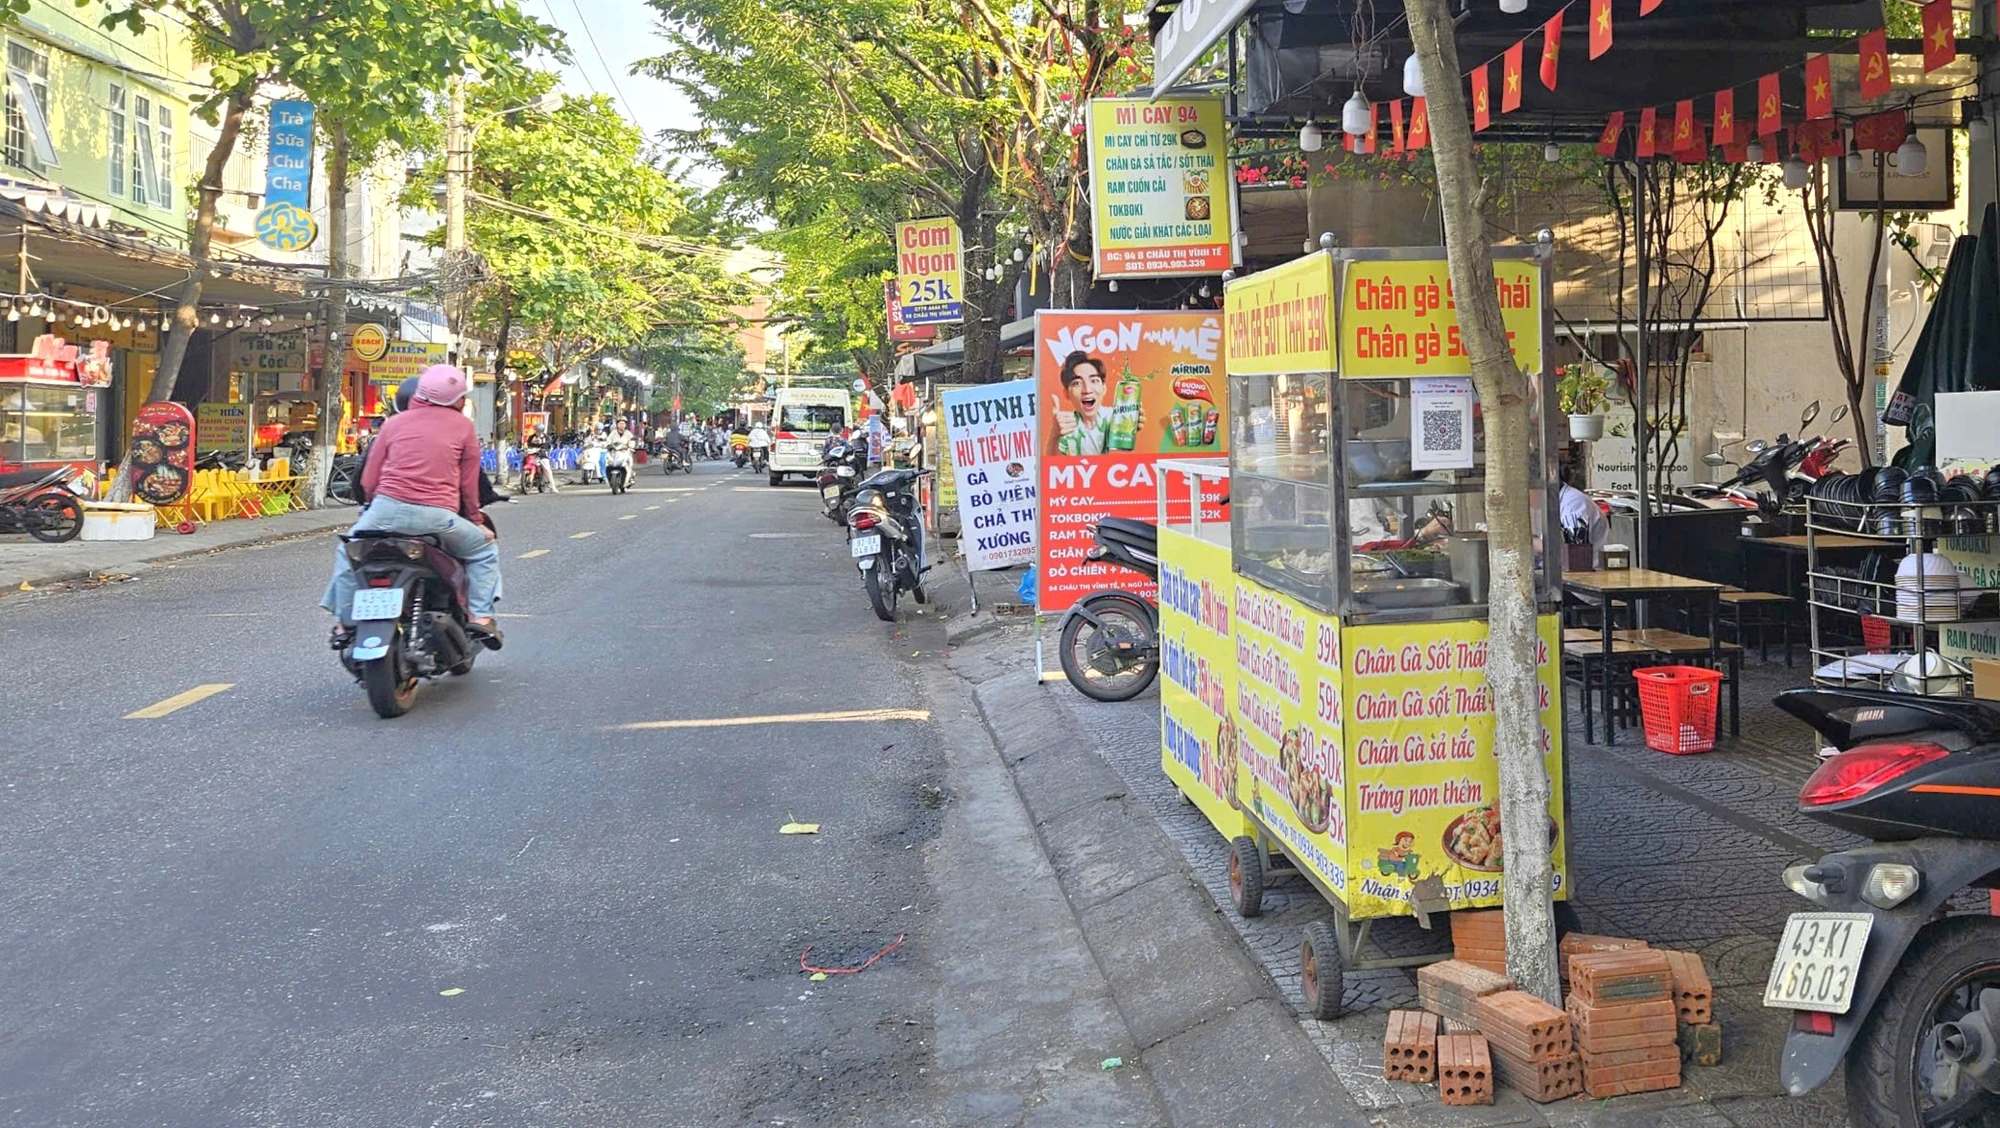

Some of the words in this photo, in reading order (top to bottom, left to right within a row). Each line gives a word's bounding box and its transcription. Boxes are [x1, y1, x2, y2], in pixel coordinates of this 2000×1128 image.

[280, 111, 304, 125] Trà
[1116, 104, 1137, 124] MÌ
[1142, 106, 1172, 124] CAY
[1177, 106, 1197, 122] 94
[275, 133, 304, 147] Sữa
[1117, 135, 1132, 147] CAY
[1163, 134, 1177, 146] 29K
[273, 155, 304, 169] Chu
[272, 176, 302, 191] Cha
[1107, 181, 1125, 194] RAM
[1109, 203, 1143, 217] TOKBOKI
[904, 226, 950, 249] Cơm
[902, 253, 956, 276] Ngon
[1125, 252, 1136, 260] 94
[909, 279, 953, 303] 25k
[1356, 275, 1407, 311] Chân
[1414, 275, 1440, 317] gà
[1045, 321, 1143, 366] NGON
[1357, 323, 1408, 359] Chân
[1415, 323, 1441, 365] gà
[967, 468, 989, 486] GÀ
[1049, 459, 1098, 490] MỲ
[1597, 463, 1638, 473] Nourisin
[1646, 462, 1688, 474] Shmpoo
[1611, 482, 1632, 491] Foot
[970, 490, 993, 508] BÒ
[977, 531, 1031, 551] XƯƠNG
[1050, 531, 1076, 542] RAM
[1050, 545, 1088, 560] CHÂN
[1070, 561, 1106, 577] CHIÊN
[1973, 564, 1987, 587] GÀ
[1276, 604, 1291, 643] Thái
[1317, 623, 1338, 667] 39k
[1946, 628, 1967, 651] RAM
[1354, 648, 1396, 676] Chân
[1401, 646, 1422, 673] Gà
[1426, 641, 1451, 672] Sốt
[1456, 641, 1488, 669] Thái
[1318, 681, 1340, 725] 59k
[1356, 692, 1398, 721] Chân
[1402, 690, 1424, 717] Gà
[1427, 686, 1451, 715] sốt
[1455, 687, 1488, 715] Thái
[1856, 708, 1885, 722] YAMAHA
[1358, 738, 1399, 766] Chân
[1403, 736, 1425, 763] Gà
[1428, 733, 1446, 761] sả
[1451, 728, 1475, 760] tắc
[1360, 783, 1404, 815] Trứng
[1408, 786, 1439, 809] non
[1443, 778, 1483, 805] thêm
[1328, 803, 1345, 845] 5k
[1329, 863, 1345, 890] 339
[1361, 879, 1400, 899] Nhận
[1464, 878, 1499, 898] 0934
[1792, 920, 1854, 960] 43-K1
